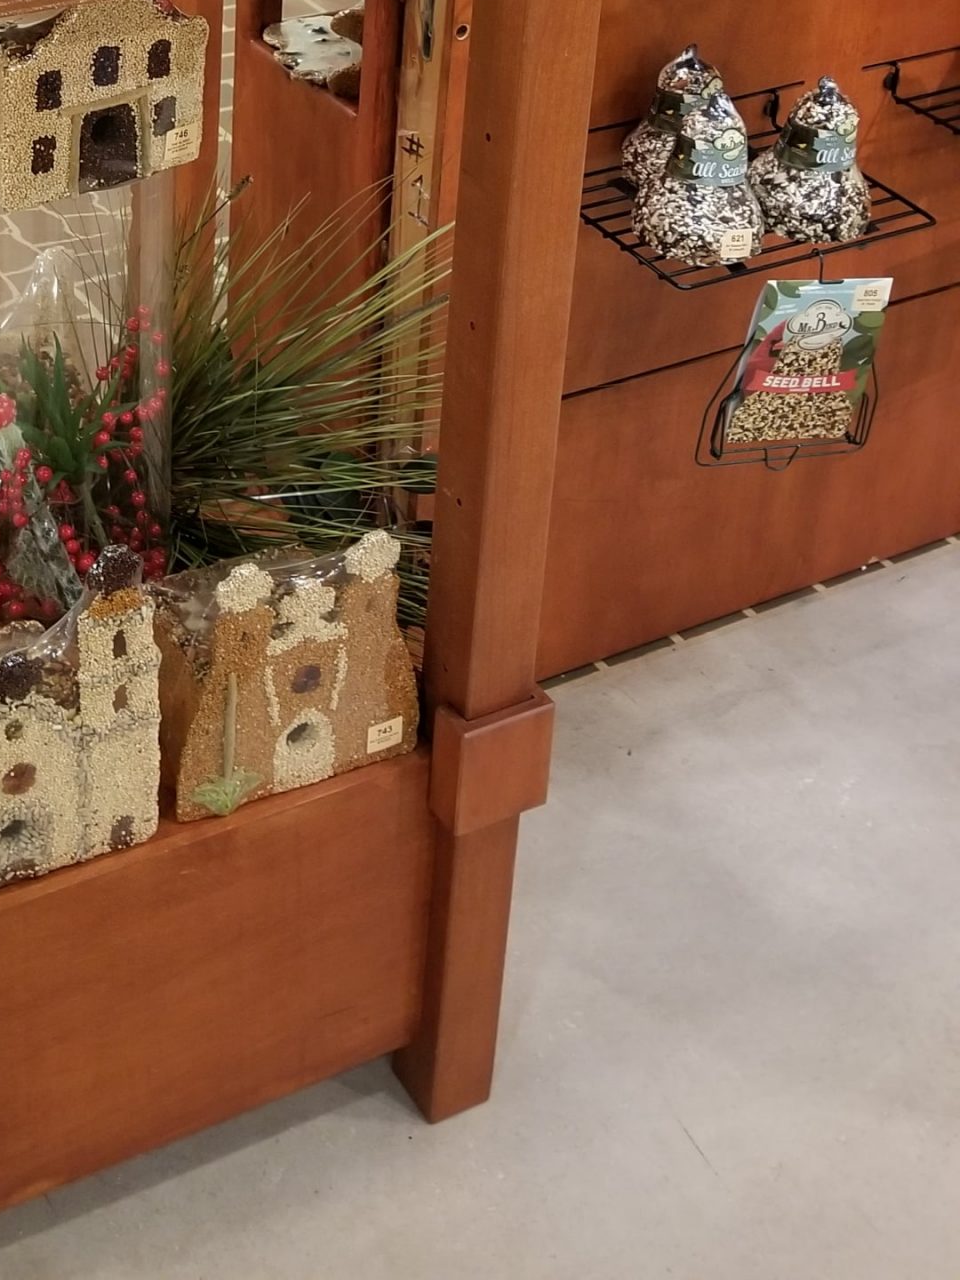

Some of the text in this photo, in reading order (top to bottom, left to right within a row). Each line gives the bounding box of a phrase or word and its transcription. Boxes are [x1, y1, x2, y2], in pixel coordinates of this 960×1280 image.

[174, 129, 189, 140] 746
[731, 234, 744, 242] 621
[762, 375, 841, 388] SEED BELL
[377, 725, 393, 737] 743
